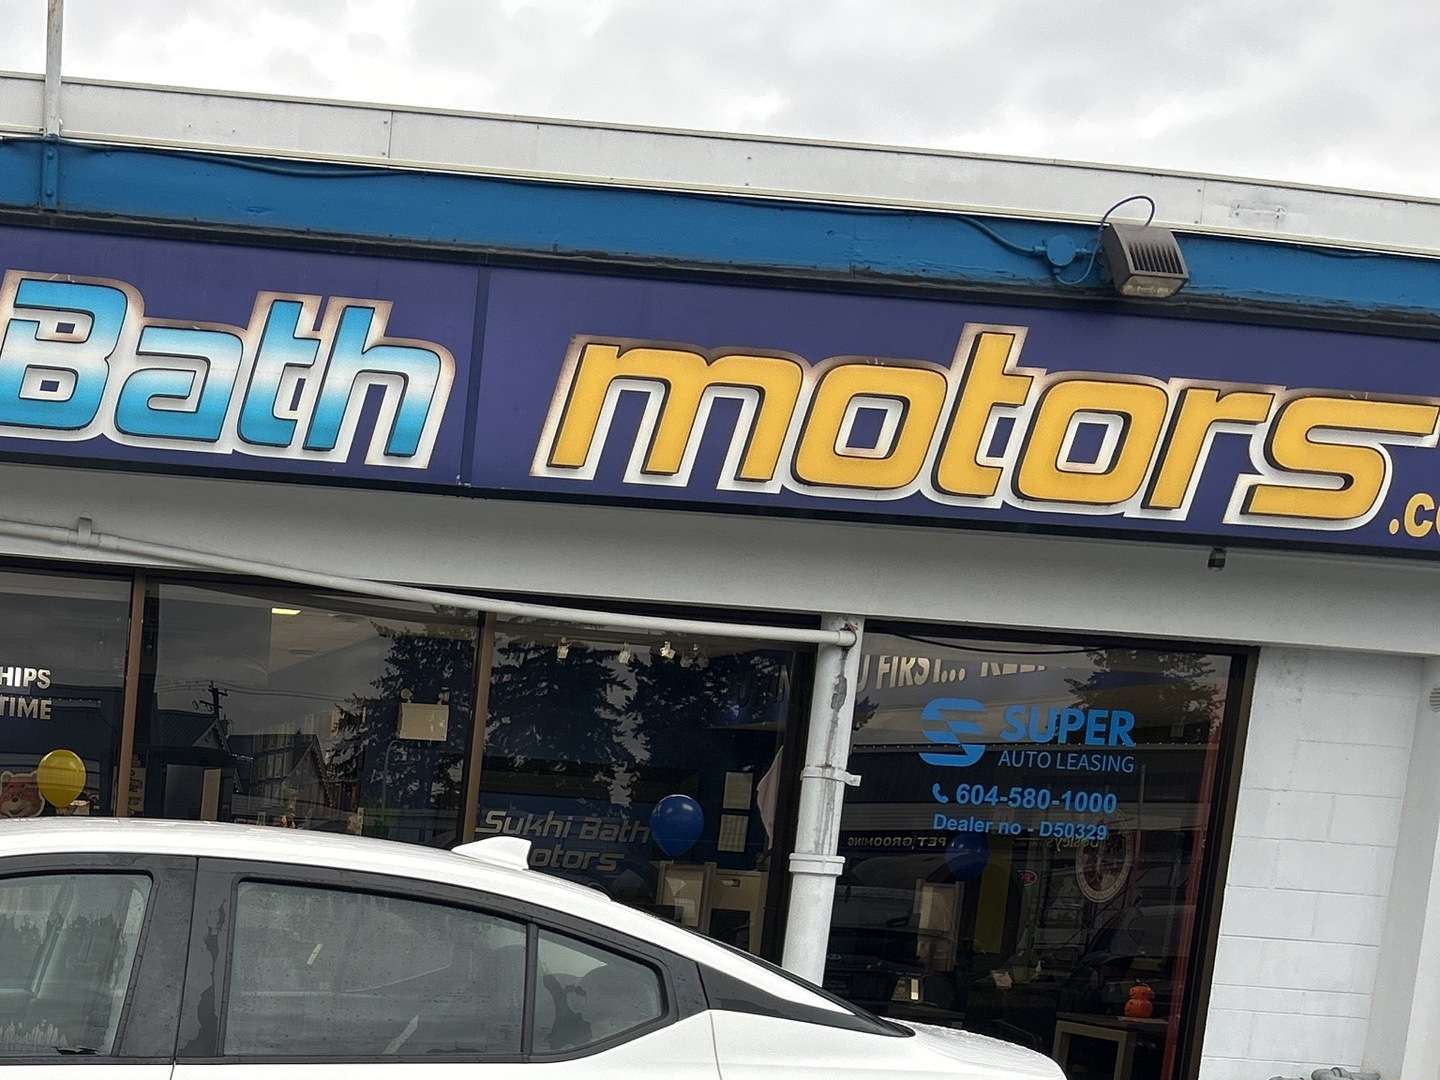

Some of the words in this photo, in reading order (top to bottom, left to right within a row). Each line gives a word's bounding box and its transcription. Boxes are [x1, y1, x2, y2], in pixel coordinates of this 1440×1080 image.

[1000, 705, 1136, 747] SUPER
[998, 750, 1051, 769] AUTO
[1056, 753, 1135, 773] LEASING
[956, 784, 1117, 814] 604-580-1000
[475, 810, 573, 839] Sukhi
[579, 816, 650, 843] Bath
[933, 813, 991, 833] Dealer
[999, 822, 1021, 835] no
[1039, 822, 1108, 841] D50329
[528, 845, 625, 872] otors
